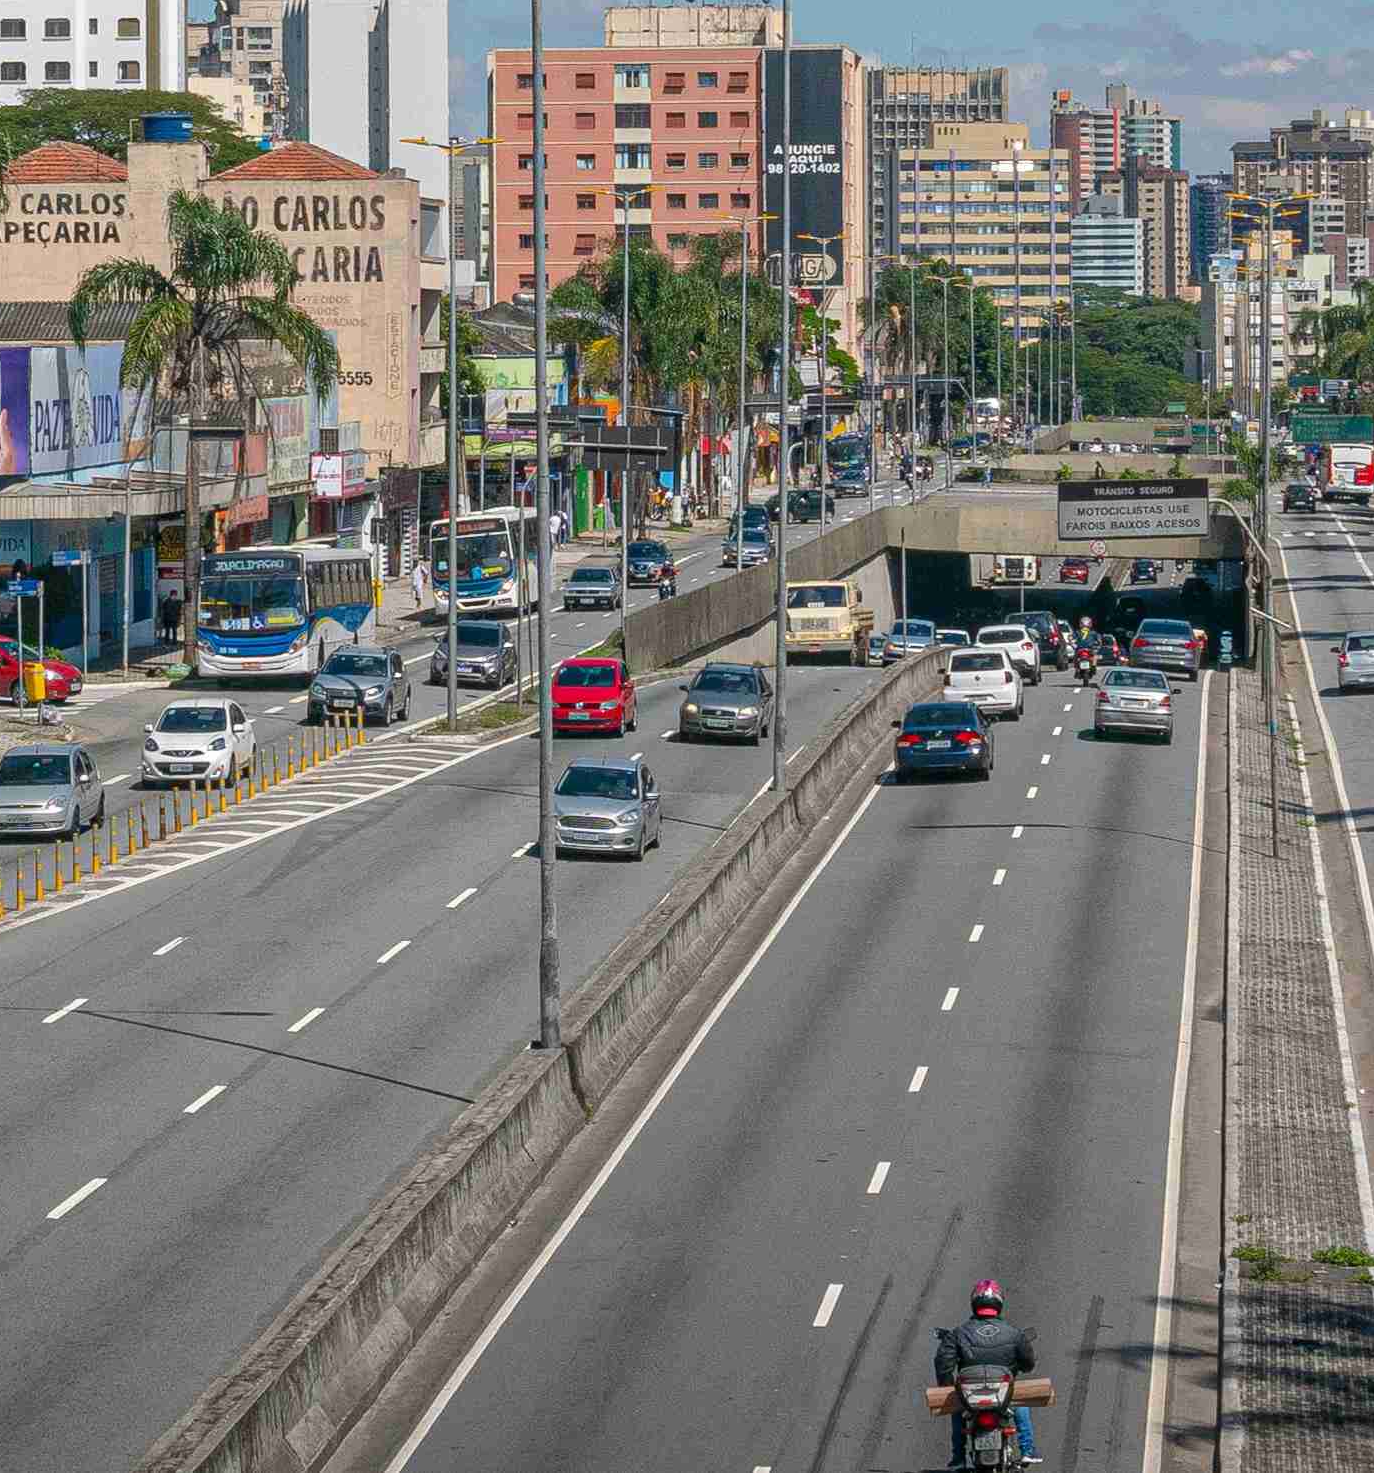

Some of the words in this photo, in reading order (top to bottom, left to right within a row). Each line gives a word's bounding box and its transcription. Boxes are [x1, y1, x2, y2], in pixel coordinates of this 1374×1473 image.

[789, 155, 823, 163] AQUI
[767, 163, 841, 174] 9820-1402
[20, 193, 127, 216] CARLOS
[273, 195, 386, 232] CARLOS
[92, 391, 121, 447] VIDA
[1139, 486, 1174, 495] SEGURO
[1076, 505, 1164, 517] MOTOCICLISTAS
[1168, 504, 1190, 514] USE
[1111, 519, 1150, 530] BAIXOS
[1156, 518, 1201, 528] ACESOS
